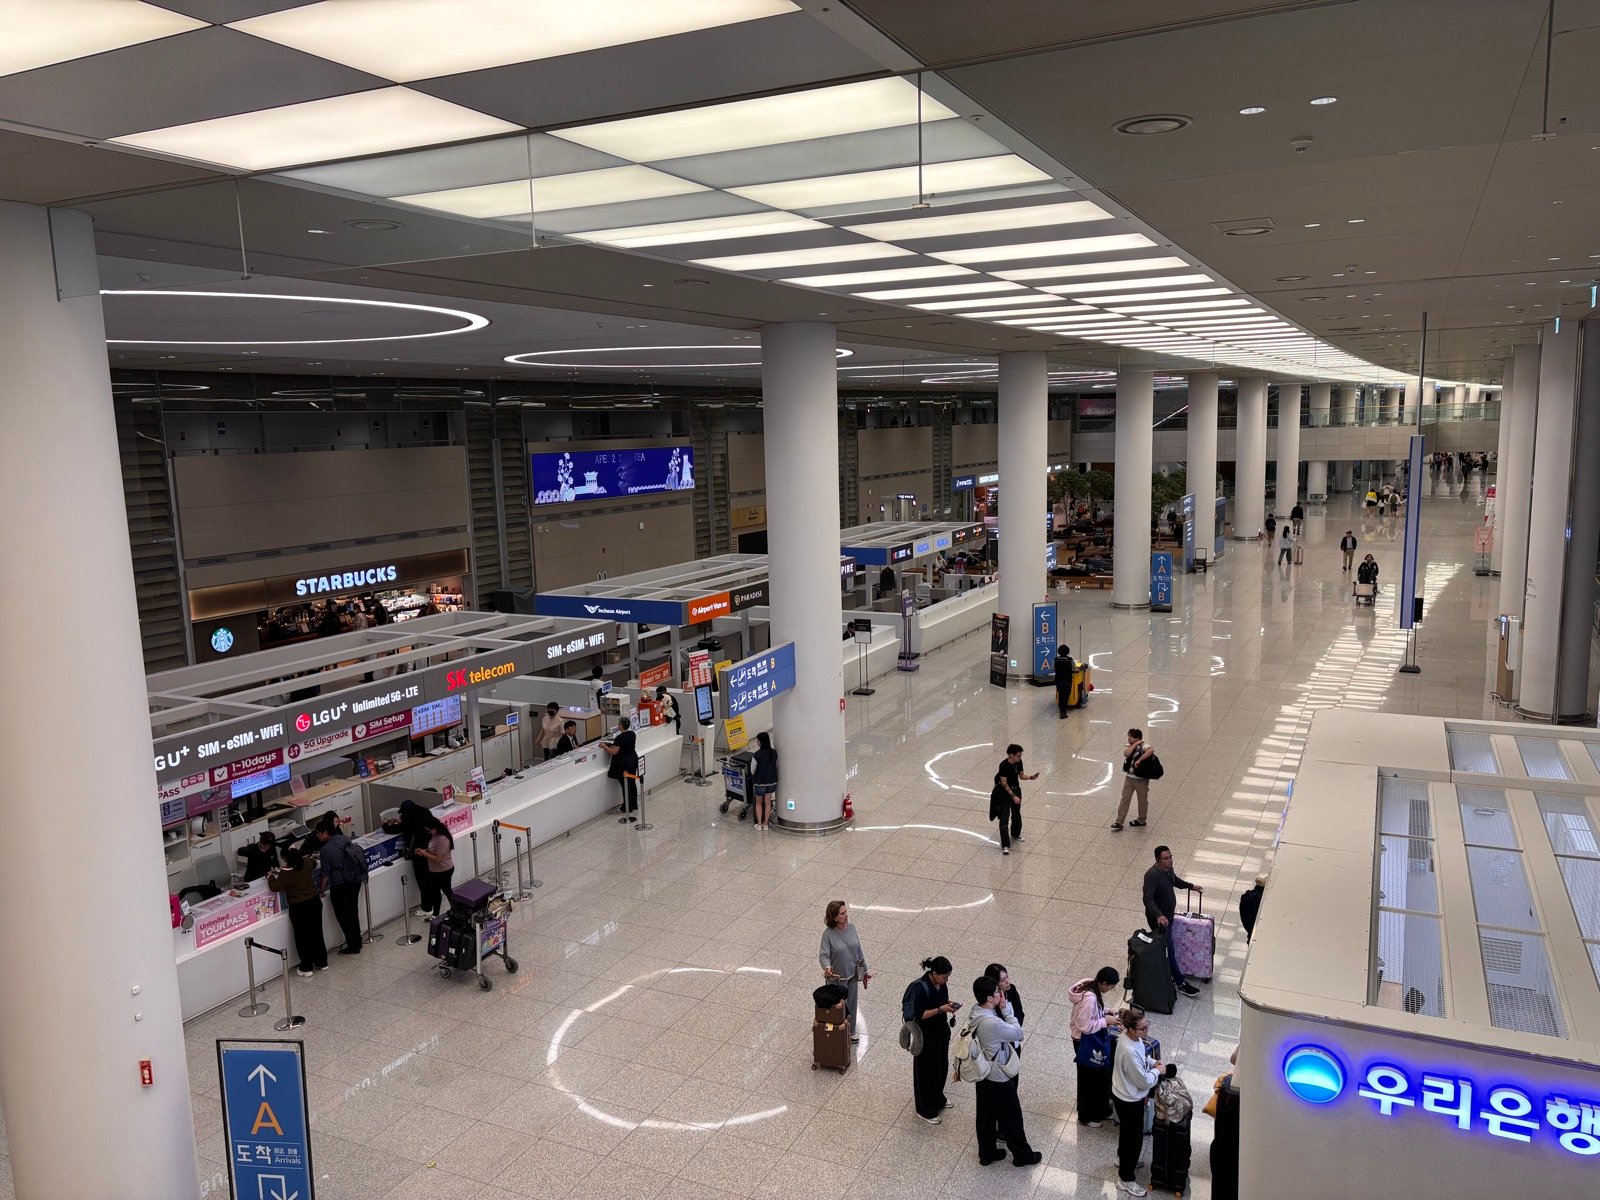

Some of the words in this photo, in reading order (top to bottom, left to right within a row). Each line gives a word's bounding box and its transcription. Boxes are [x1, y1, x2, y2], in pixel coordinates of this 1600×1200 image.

[1157, 564, 1166, 574] A
[295, 565, 397, 596] STARBUCKS
[740, 590, 763, 602] PARADISE
[1158, 592, 1165, 601] B
[697, 603, 714, 615] Airport
[1041, 622, 1049, 634] B
[547, 644, 562, 659] SIM
[566, 637, 585, 654] eSIM
[589, 632, 605, 647] WiFi
[1040, 658, 1051, 671] A
[446, 667, 467, 691] SK
[469, 660, 515, 684] telecom
[771, 679, 777, 691] A
[352, 693, 390, 713] Unlimited
[390, 690, 401, 703] 5G
[405, 685, 418, 698] LTE
[369, 720, 383, 730] SIM
[383, 713, 405, 726] Setup
[197, 740, 220, 758] SIM
[226, 731, 254, 750] eSIM
[260, 722, 284, 740] WiFi
[303, 739, 316, 749] 5G
[316, 730, 349, 745] Upgrade
[449, 810, 468, 826] Free!
[370, 851, 381, 861] Taxi
[200, 913, 230, 930] Unlimited
[201, 922, 227, 938] TOUR
[226, 911, 249, 928] PASS
[250, 1101, 284, 1136] A
[1357, 1065, 1600, 1155] 우리은행
[236, 1144, 272, 1165] 도착
[274, 1156, 301, 1165] Arrivals
